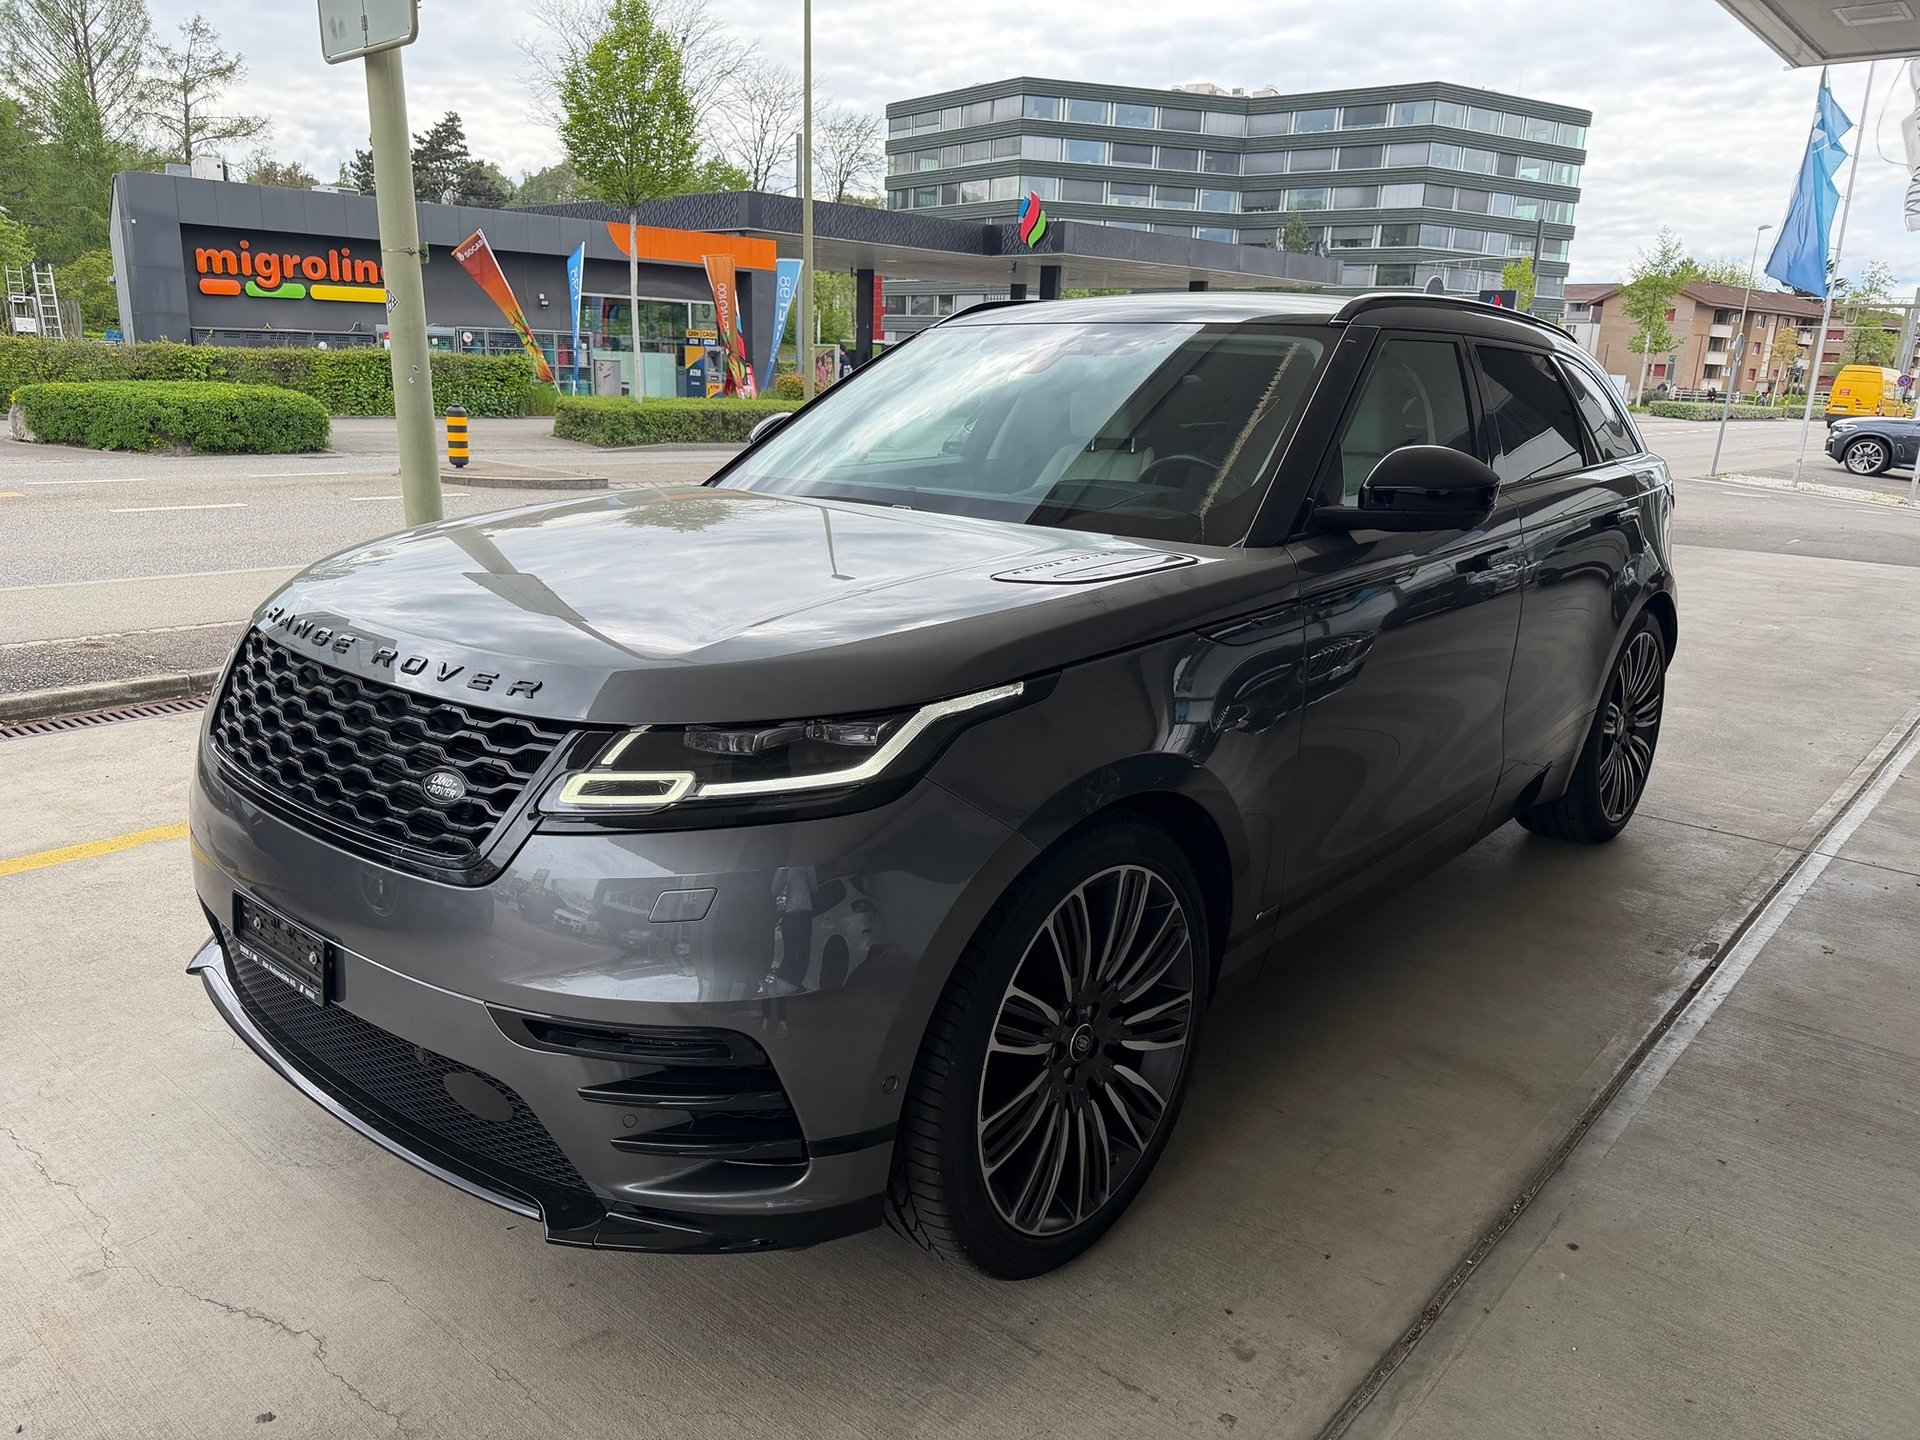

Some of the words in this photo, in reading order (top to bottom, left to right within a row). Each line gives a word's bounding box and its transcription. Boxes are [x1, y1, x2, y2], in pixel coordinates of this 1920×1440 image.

[463, 239, 484, 258] SOCAR
[195, 239, 385, 288] migrolin
[689, 369, 702, 377] ATM
[267, 605, 356, 654] RANGE
[370, 646, 544, 699] ROVER
[431, 774, 454, 787] LAND
[430, 784, 457, 798] ROVER
